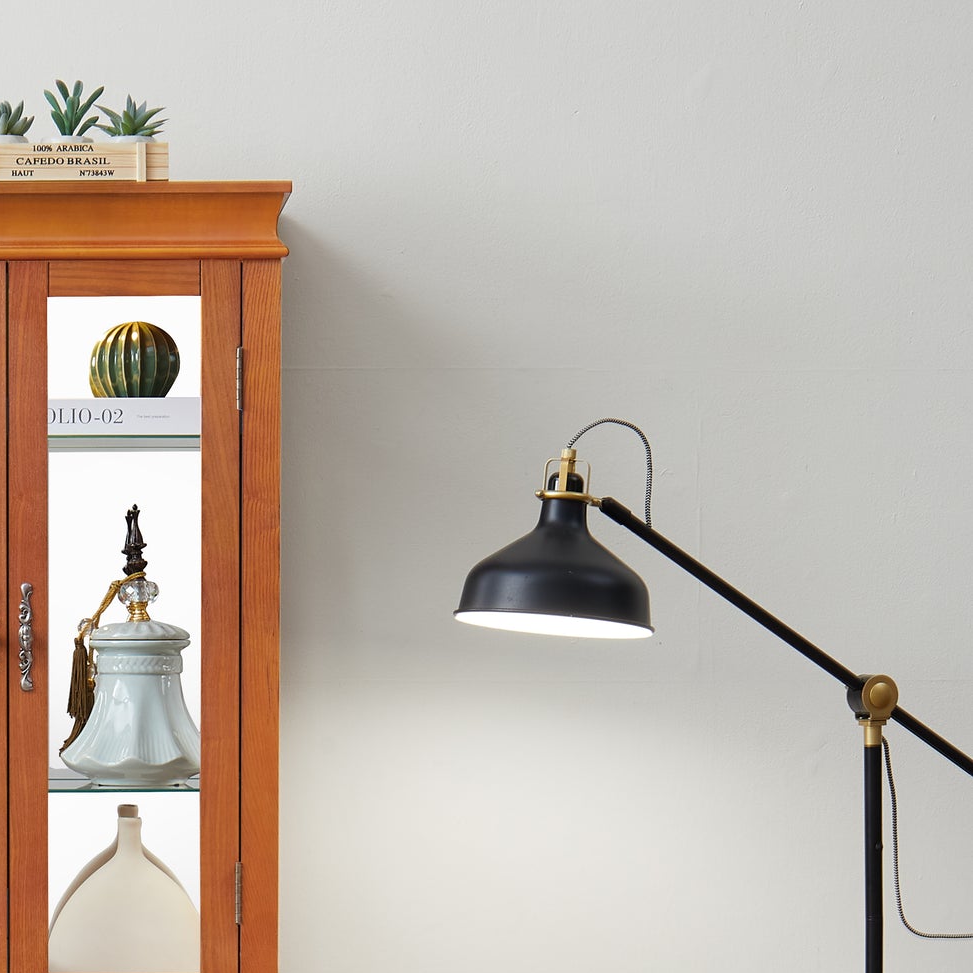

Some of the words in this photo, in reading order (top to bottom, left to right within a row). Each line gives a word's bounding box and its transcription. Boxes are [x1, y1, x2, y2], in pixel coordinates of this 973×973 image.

[32, 144, 52, 152] 100%
[56, 144, 94, 152] ARABICA
[16, 157, 64, 165] CAFEDO
[67, 157, 111, 165] BRASIL
